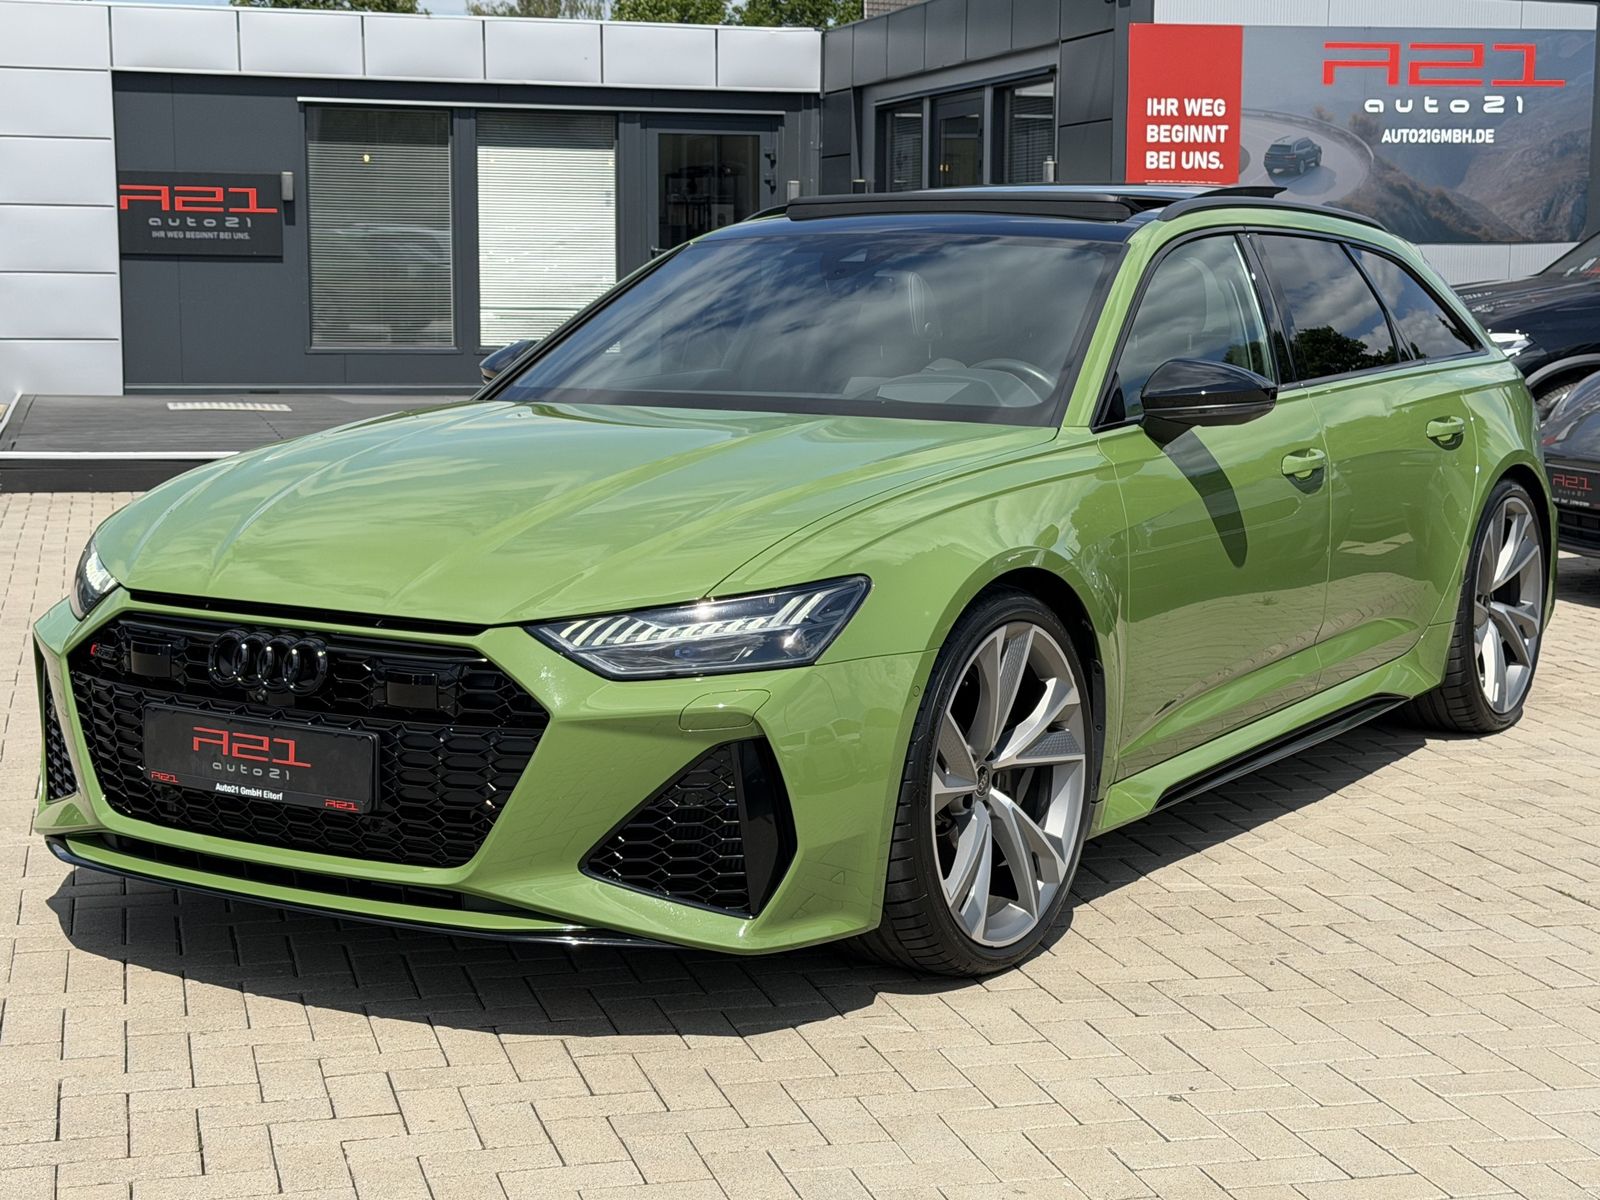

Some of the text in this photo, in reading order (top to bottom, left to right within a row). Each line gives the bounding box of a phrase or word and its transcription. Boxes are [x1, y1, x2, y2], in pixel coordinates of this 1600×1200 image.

[1322, 41, 1567, 88] A21
[1146, 97, 1227, 117] IHR WEG
[1363, 95, 1524, 114] auto21
[1145, 124, 1229, 143] BEGINNT
[1381, 128, 1496, 144] AUTO21GMBH.DE
[1145, 150, 1225, 170] BEI UNS.
[118, 184, 279, 213] A21
[147, 216, 252, 228] auto21
[151, 230, 251, 241] IHR WEG BEGINNT BEI UNS.
[192, 726, 312, 768] A21
[212, 761, 291, 780] auto21
[215, 782, 284, 801] Auto21 GmbH Eitorf
